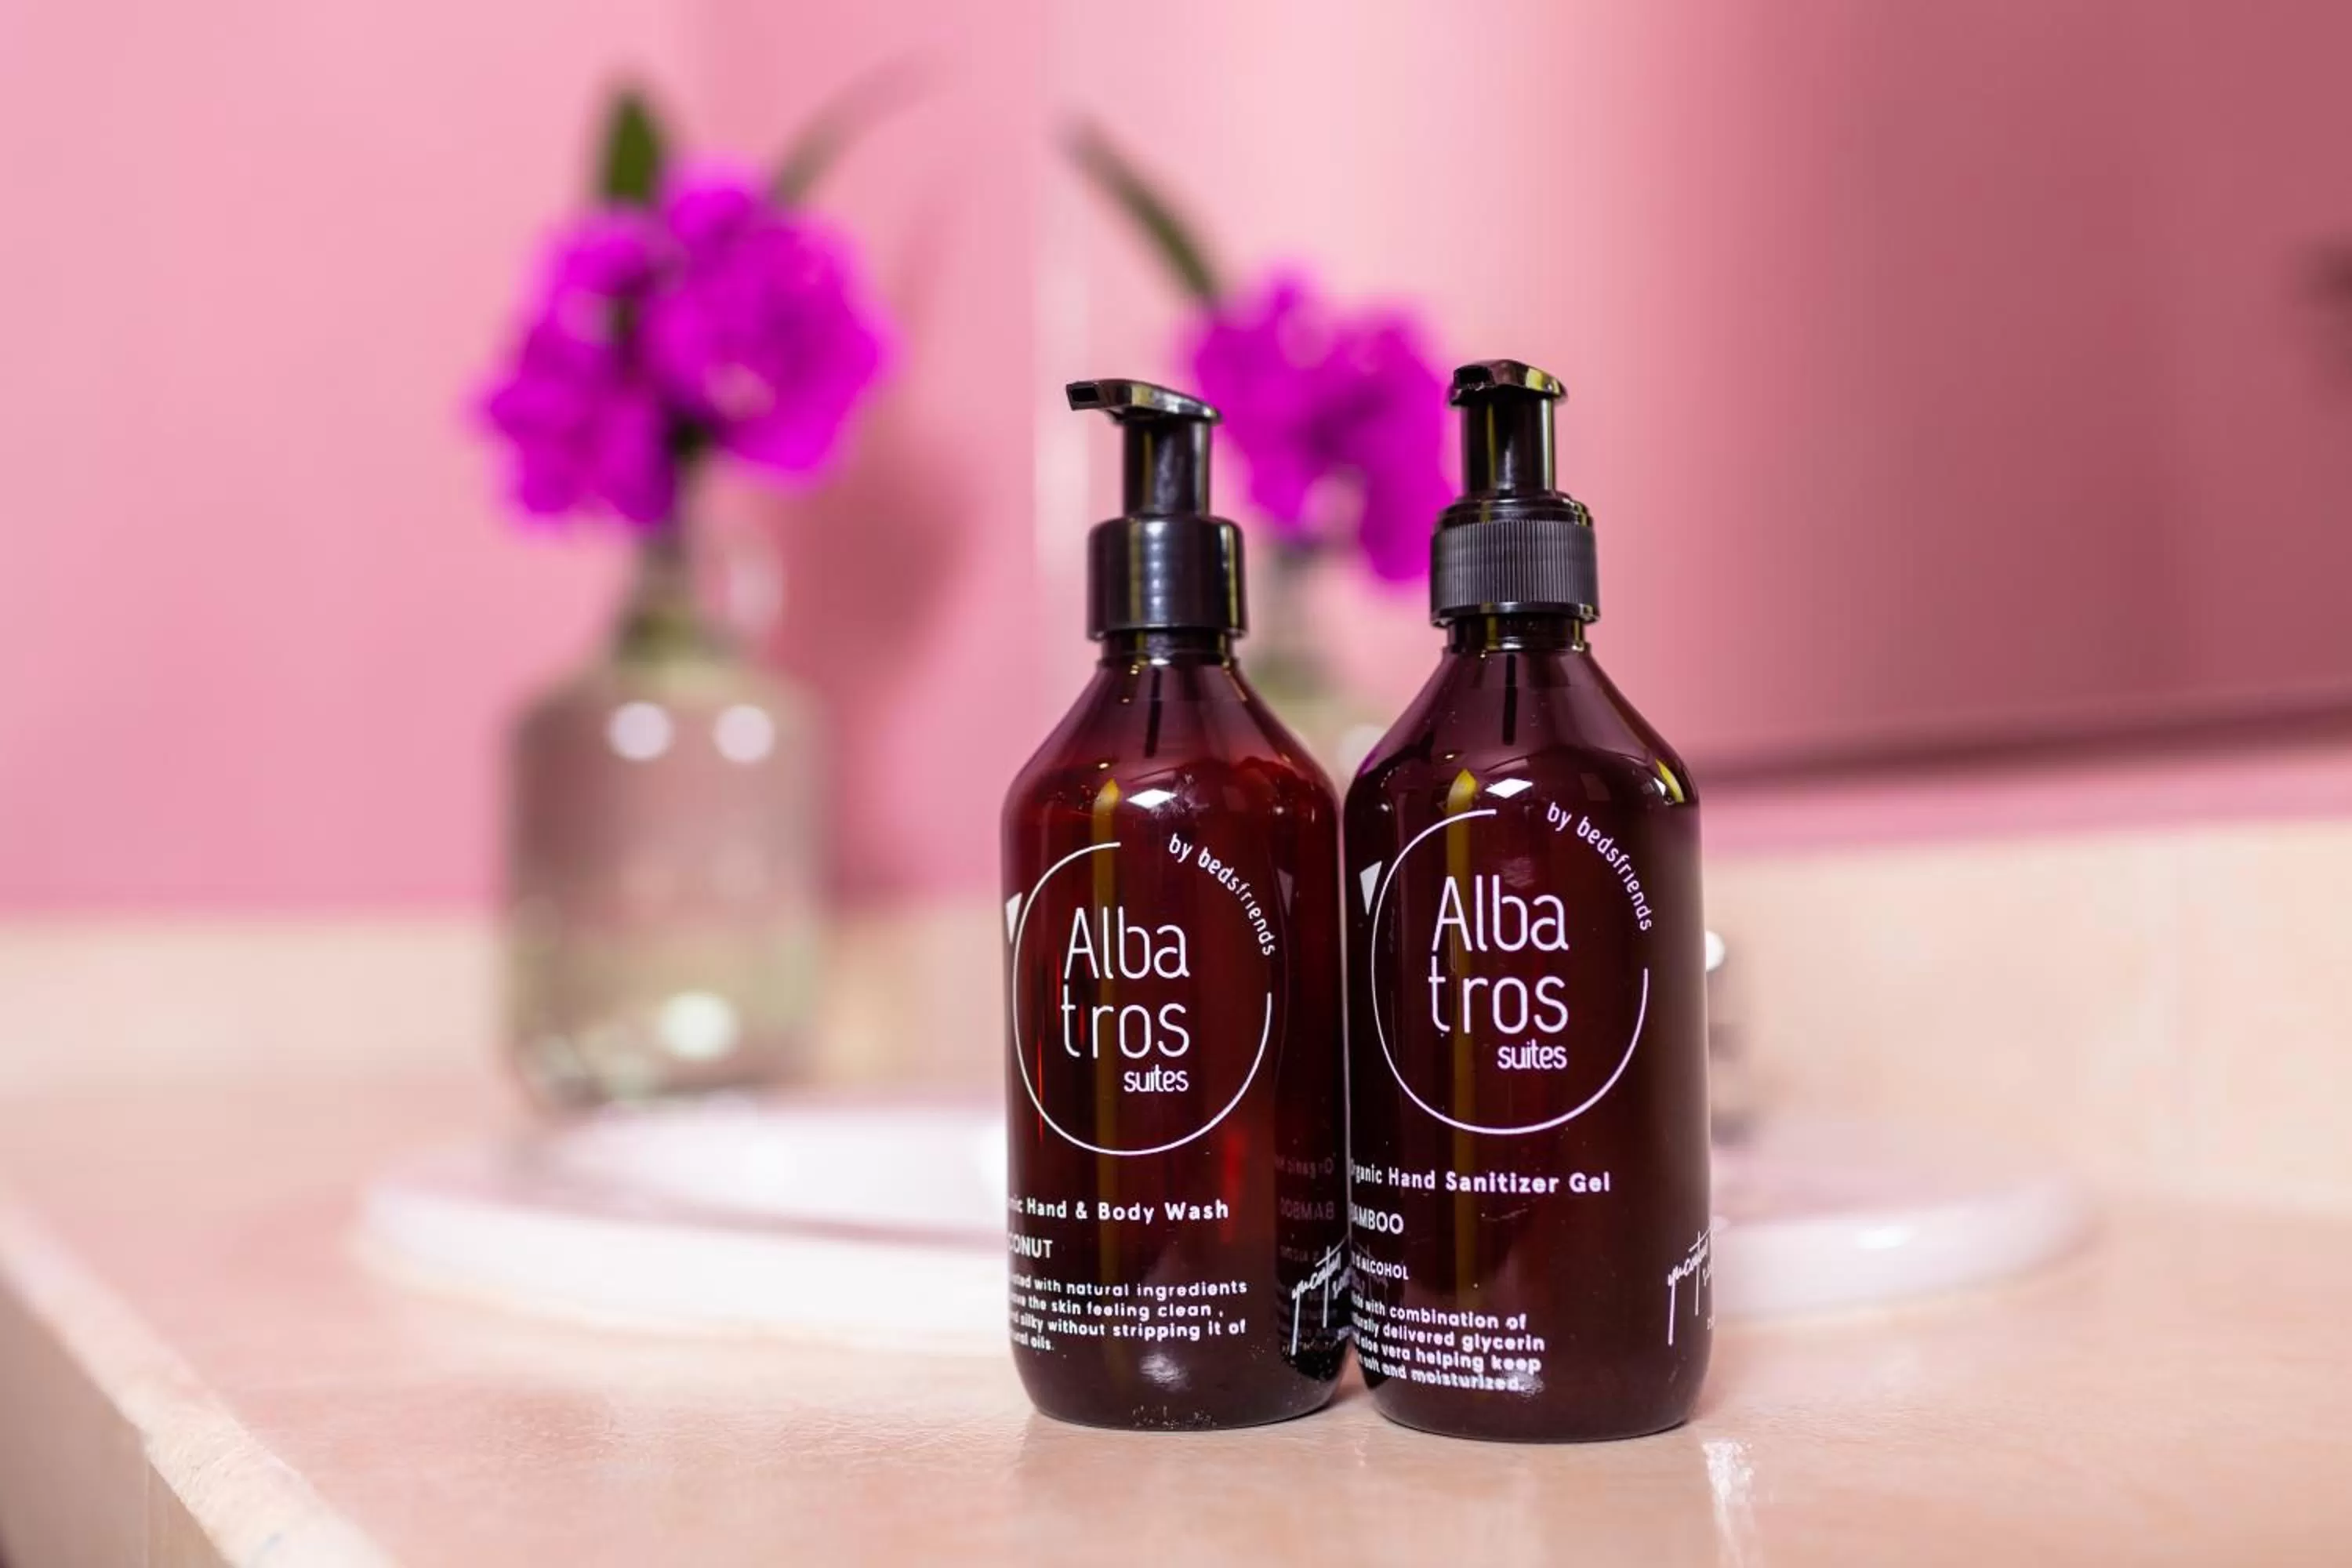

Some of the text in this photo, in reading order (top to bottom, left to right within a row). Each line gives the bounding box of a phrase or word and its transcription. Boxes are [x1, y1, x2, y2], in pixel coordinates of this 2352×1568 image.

[1546, 802, 1653, 932] by bedsfriends
[1168, 833, 1276, 956] by bedsfriends
[1432, 875, 1569, 952] Alba
[1063, 906, 1190, 979] Alba
[1428, 956, 1569, 1034] tros
[1061, 983, 1190, 1058] tros
[1497, 1039, 1567, 1069] suites
[1123, 1064, 1189, 1092] suites
[1388, 1167, 1436, 1190] Hand
[1445, 1171, 1559, 1193] Sanitizer
[1569, 1171, 1610, 1192] Gel
[1026, 1196, 1067, 1219] Hand
[1075, 1200, 1088, 1219] &
[1098, 1201, 1155, 1225] Body
[1164, 1199, 1229, 1221] Wash
[1033, 1277, 1062, 1294] with
[1066, 1282, 1129, 1297] natural
[1137, 1279, 1248, 1302] ingredients
[1028, 1294, 1047, 1311] the
[1051, 1299, 1081, 1316] skin
[1087, 1301, 1150, 1323] feeling
[1157, 1302, 1211, 1318] clean
[1389, 1307, 1500, 1330] combination
[1505, 1312, 1527, 1330] of
[1047, 1319, 1105, 1337] without
[1112, 1322, 1200, 1342] stripping
[1208, 1319, 1221, 1336] it
[1228, 1318, 1247, 1335] of
[1382, 1322, 1455, 1347] delivered
[1461, 1332, 1545, 1353] glycerin
[1381, 1343, 1410, 1361] vera
[1416, 1346, 1484, 1374] helping
[1490, 1354, 1542, 1376] keep
[1381, 1362, 1407, 1380] and
